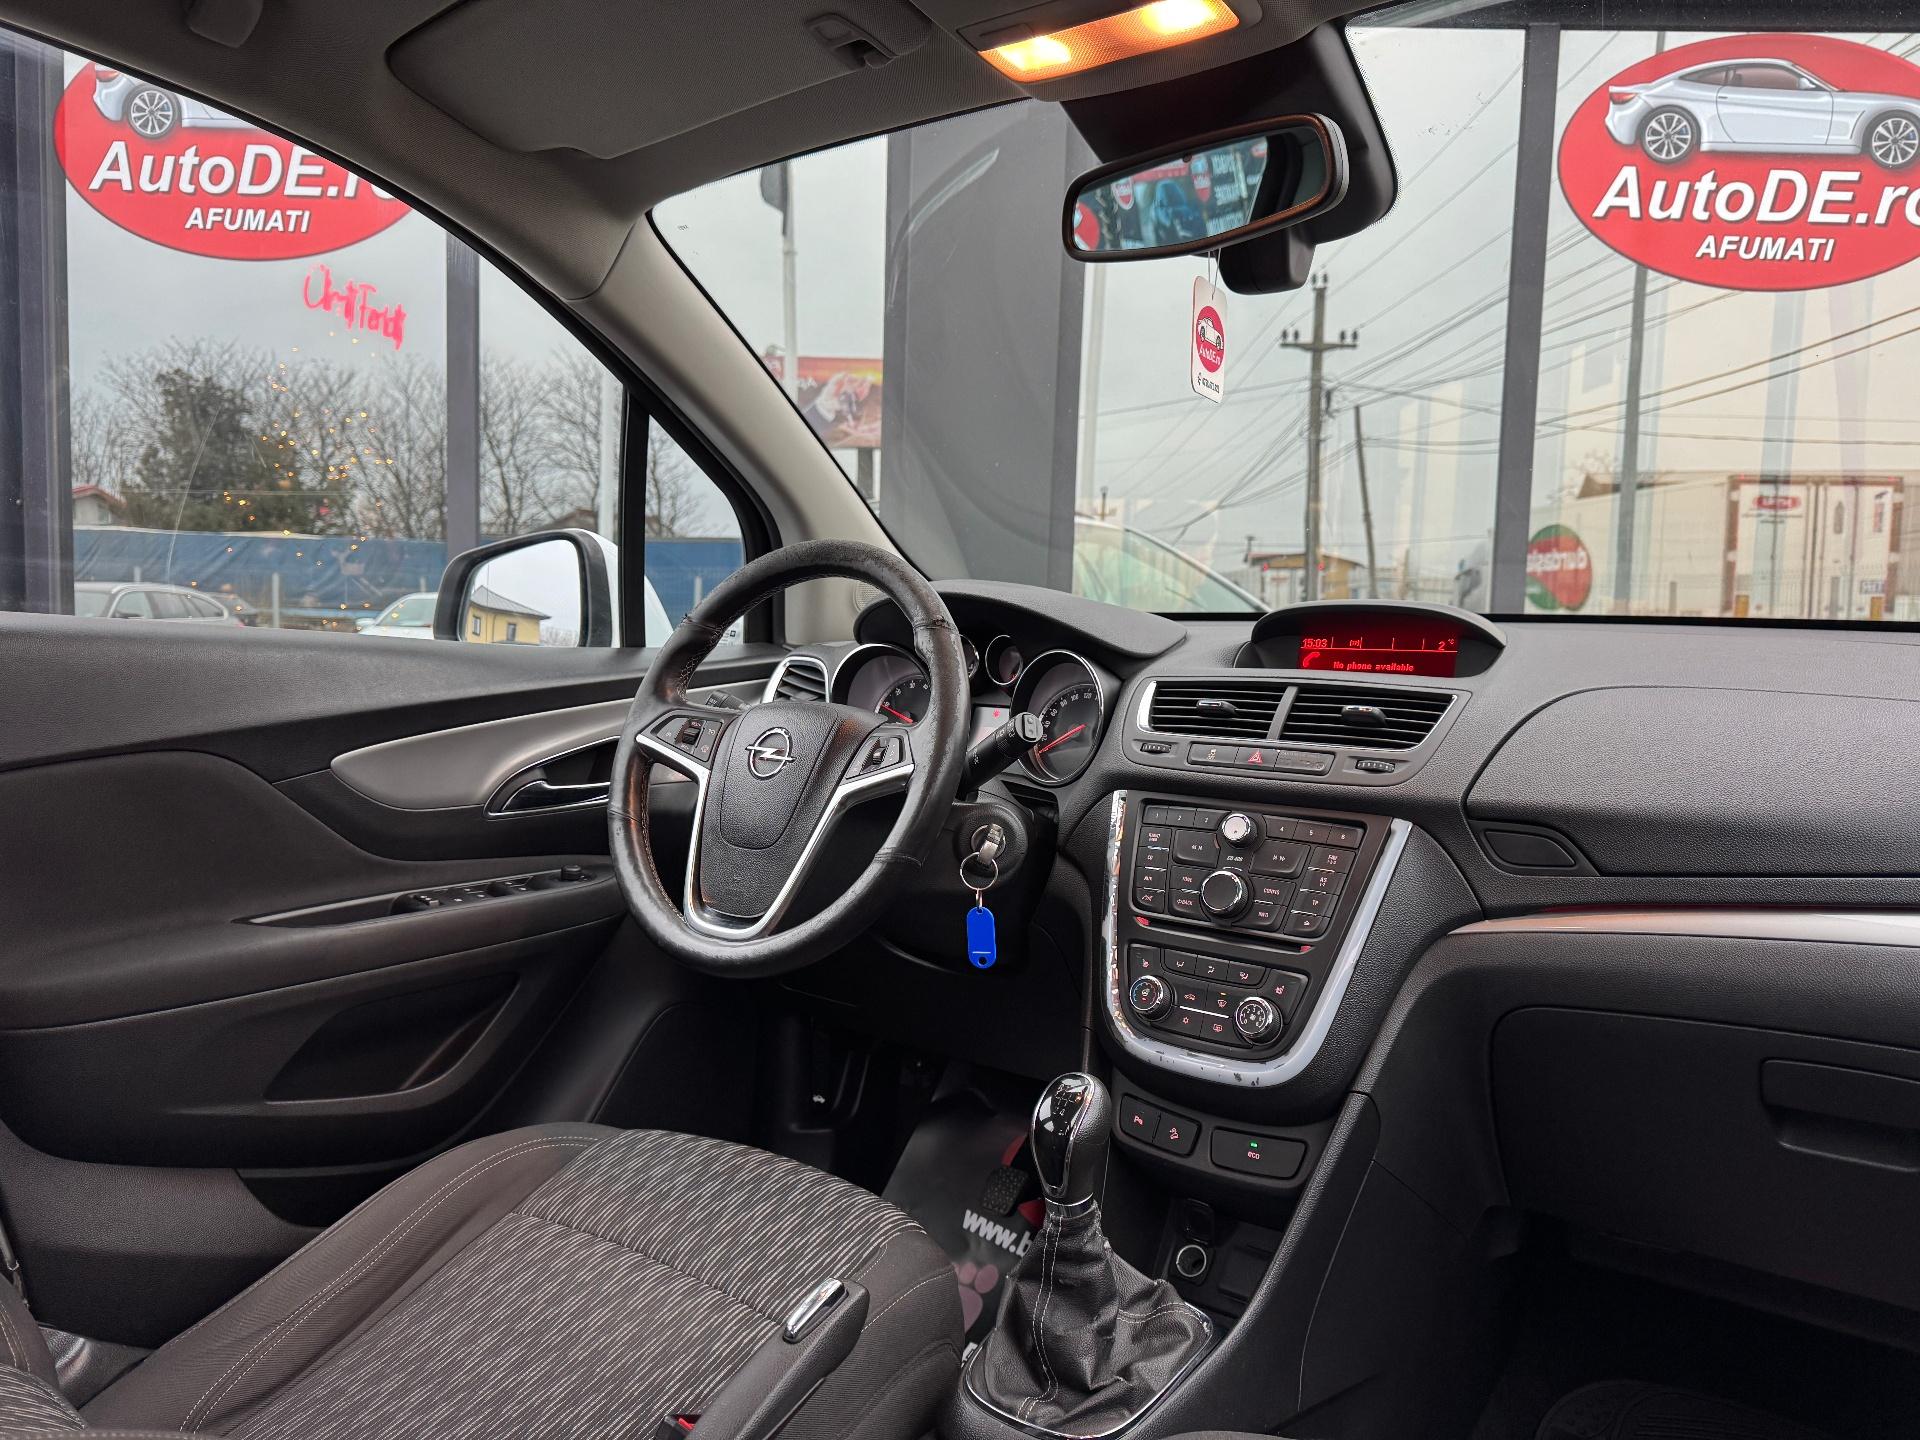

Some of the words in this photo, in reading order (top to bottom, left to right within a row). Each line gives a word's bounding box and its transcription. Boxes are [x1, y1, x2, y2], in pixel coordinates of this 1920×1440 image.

[184, 207, 312, 233] AFUMATI
[1695, 235, 1835, 261] AFUMATI
[1302, 638, 1328, 649] 15:03
[1333, 661, 1344, 669] No
[1346, 662, 1372, 672] phone
[1375, 662, 1415, 672] available
